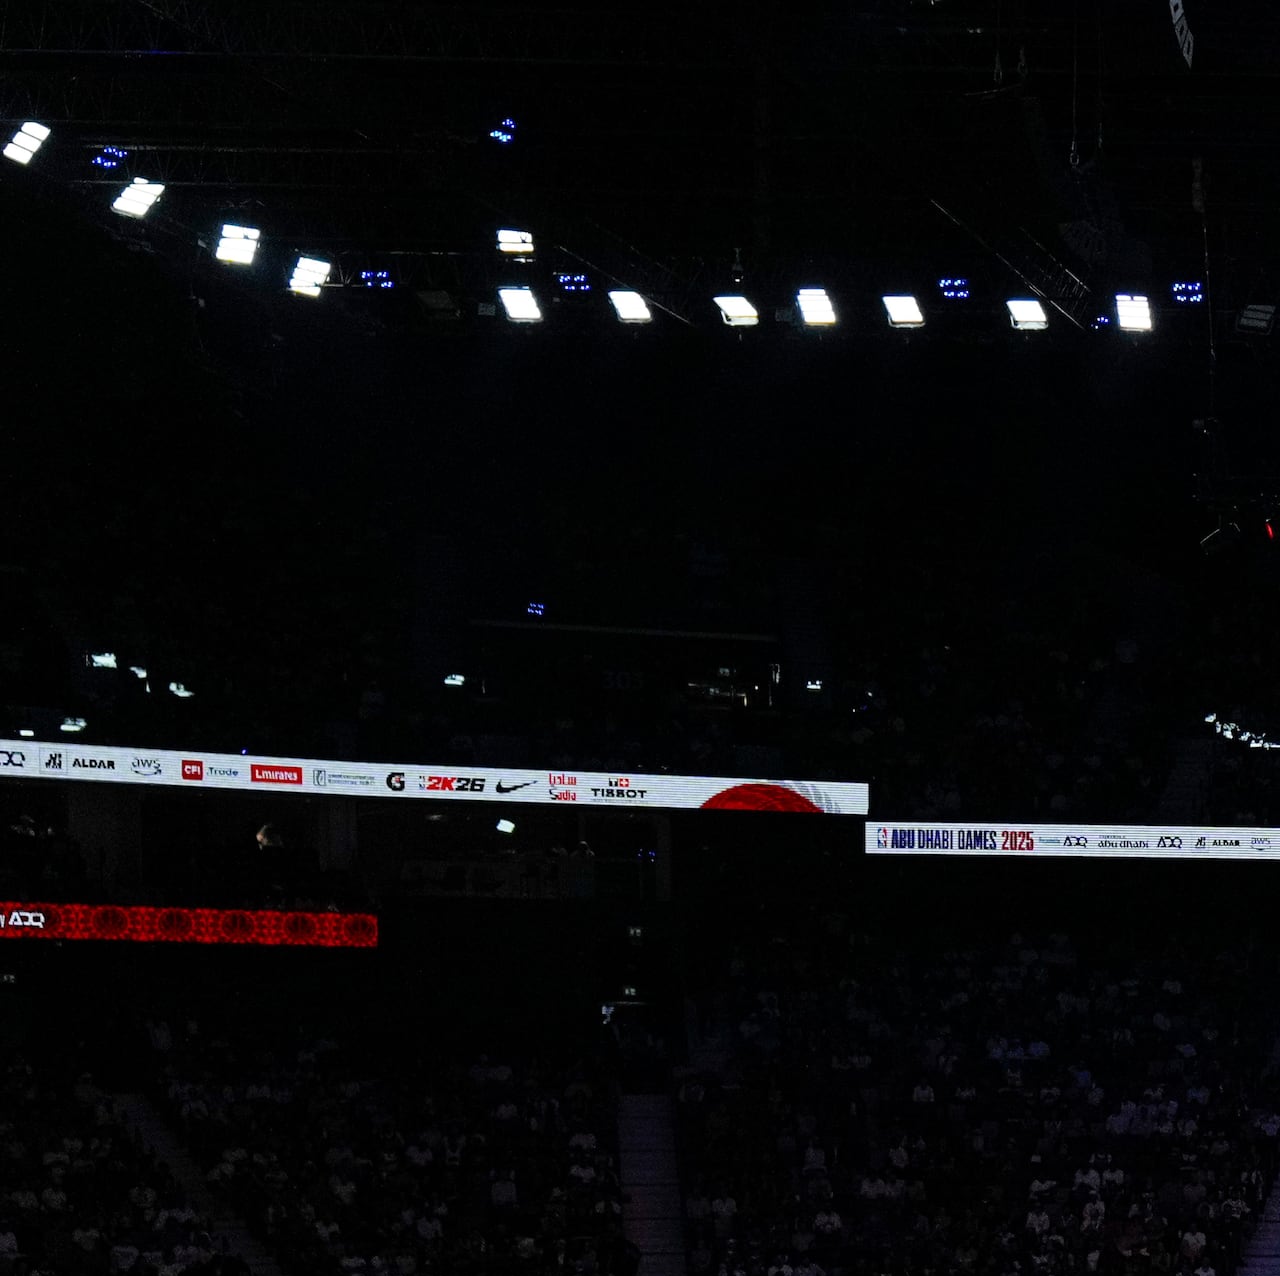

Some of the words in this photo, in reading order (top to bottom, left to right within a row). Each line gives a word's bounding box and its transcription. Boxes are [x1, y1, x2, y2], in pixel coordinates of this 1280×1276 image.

[72, 757, 115, 770] ALDAR
[132, 757, 161, 770] aws
[426, 775, 486, 792] 2K26
[549, 788, 577, 801] Sadia
[591, 788, 647, 799] TISSOT
[891, 829, 915, 849] ABU
[917, 829, 951, 850] DHABI
[957, 830, 997, 850] GAMES
[1001, 831, 1034, 851] 2025
